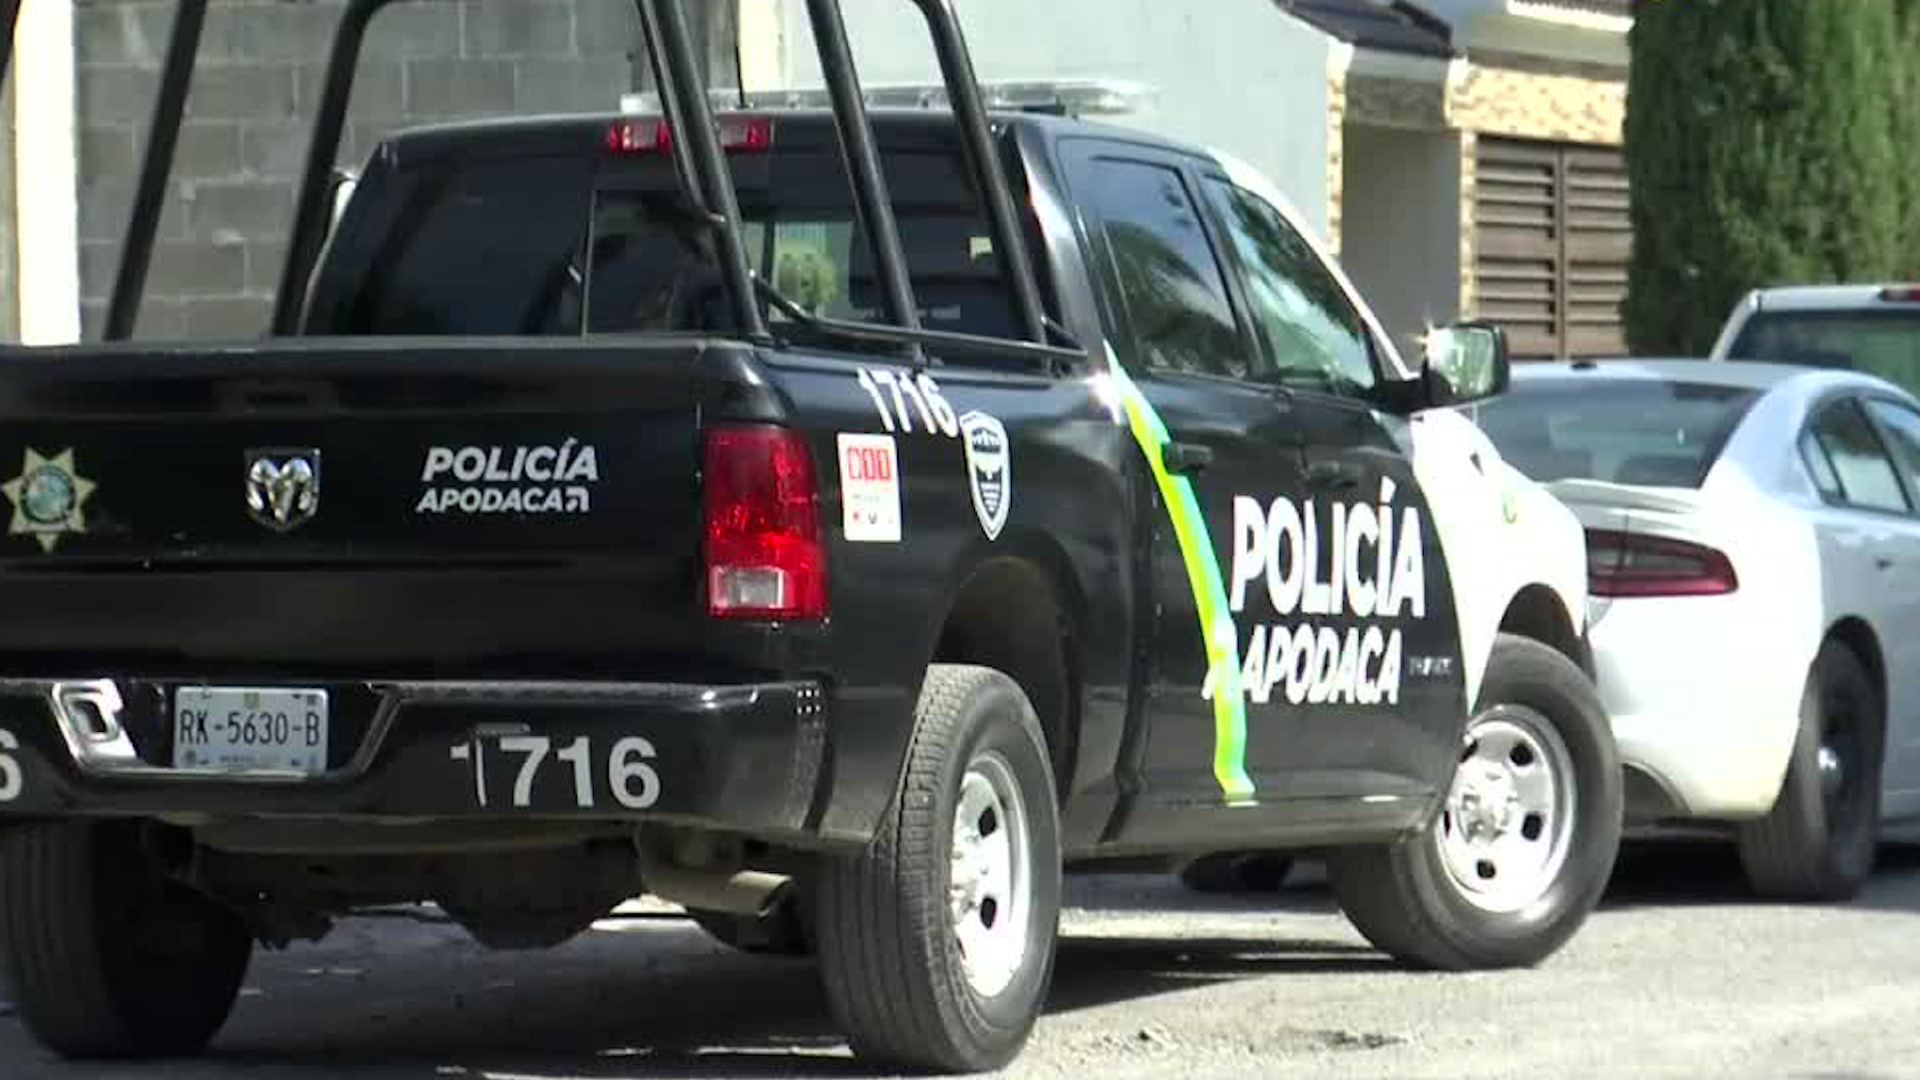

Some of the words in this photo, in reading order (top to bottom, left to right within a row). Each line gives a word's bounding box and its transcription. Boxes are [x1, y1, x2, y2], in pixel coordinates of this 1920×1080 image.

[857, 367, 959, 438] 1716
[422, 437, 599, 482] POLICÍA
[417, 488, 564, 513] APODACA
[1230, 475, 1425, 617] POLICÍA
[1241, 623, 1402, 705] APODACA
[180, 709, 320, 747] RK-5630-B
[450, 736, 661, 809] 1716
